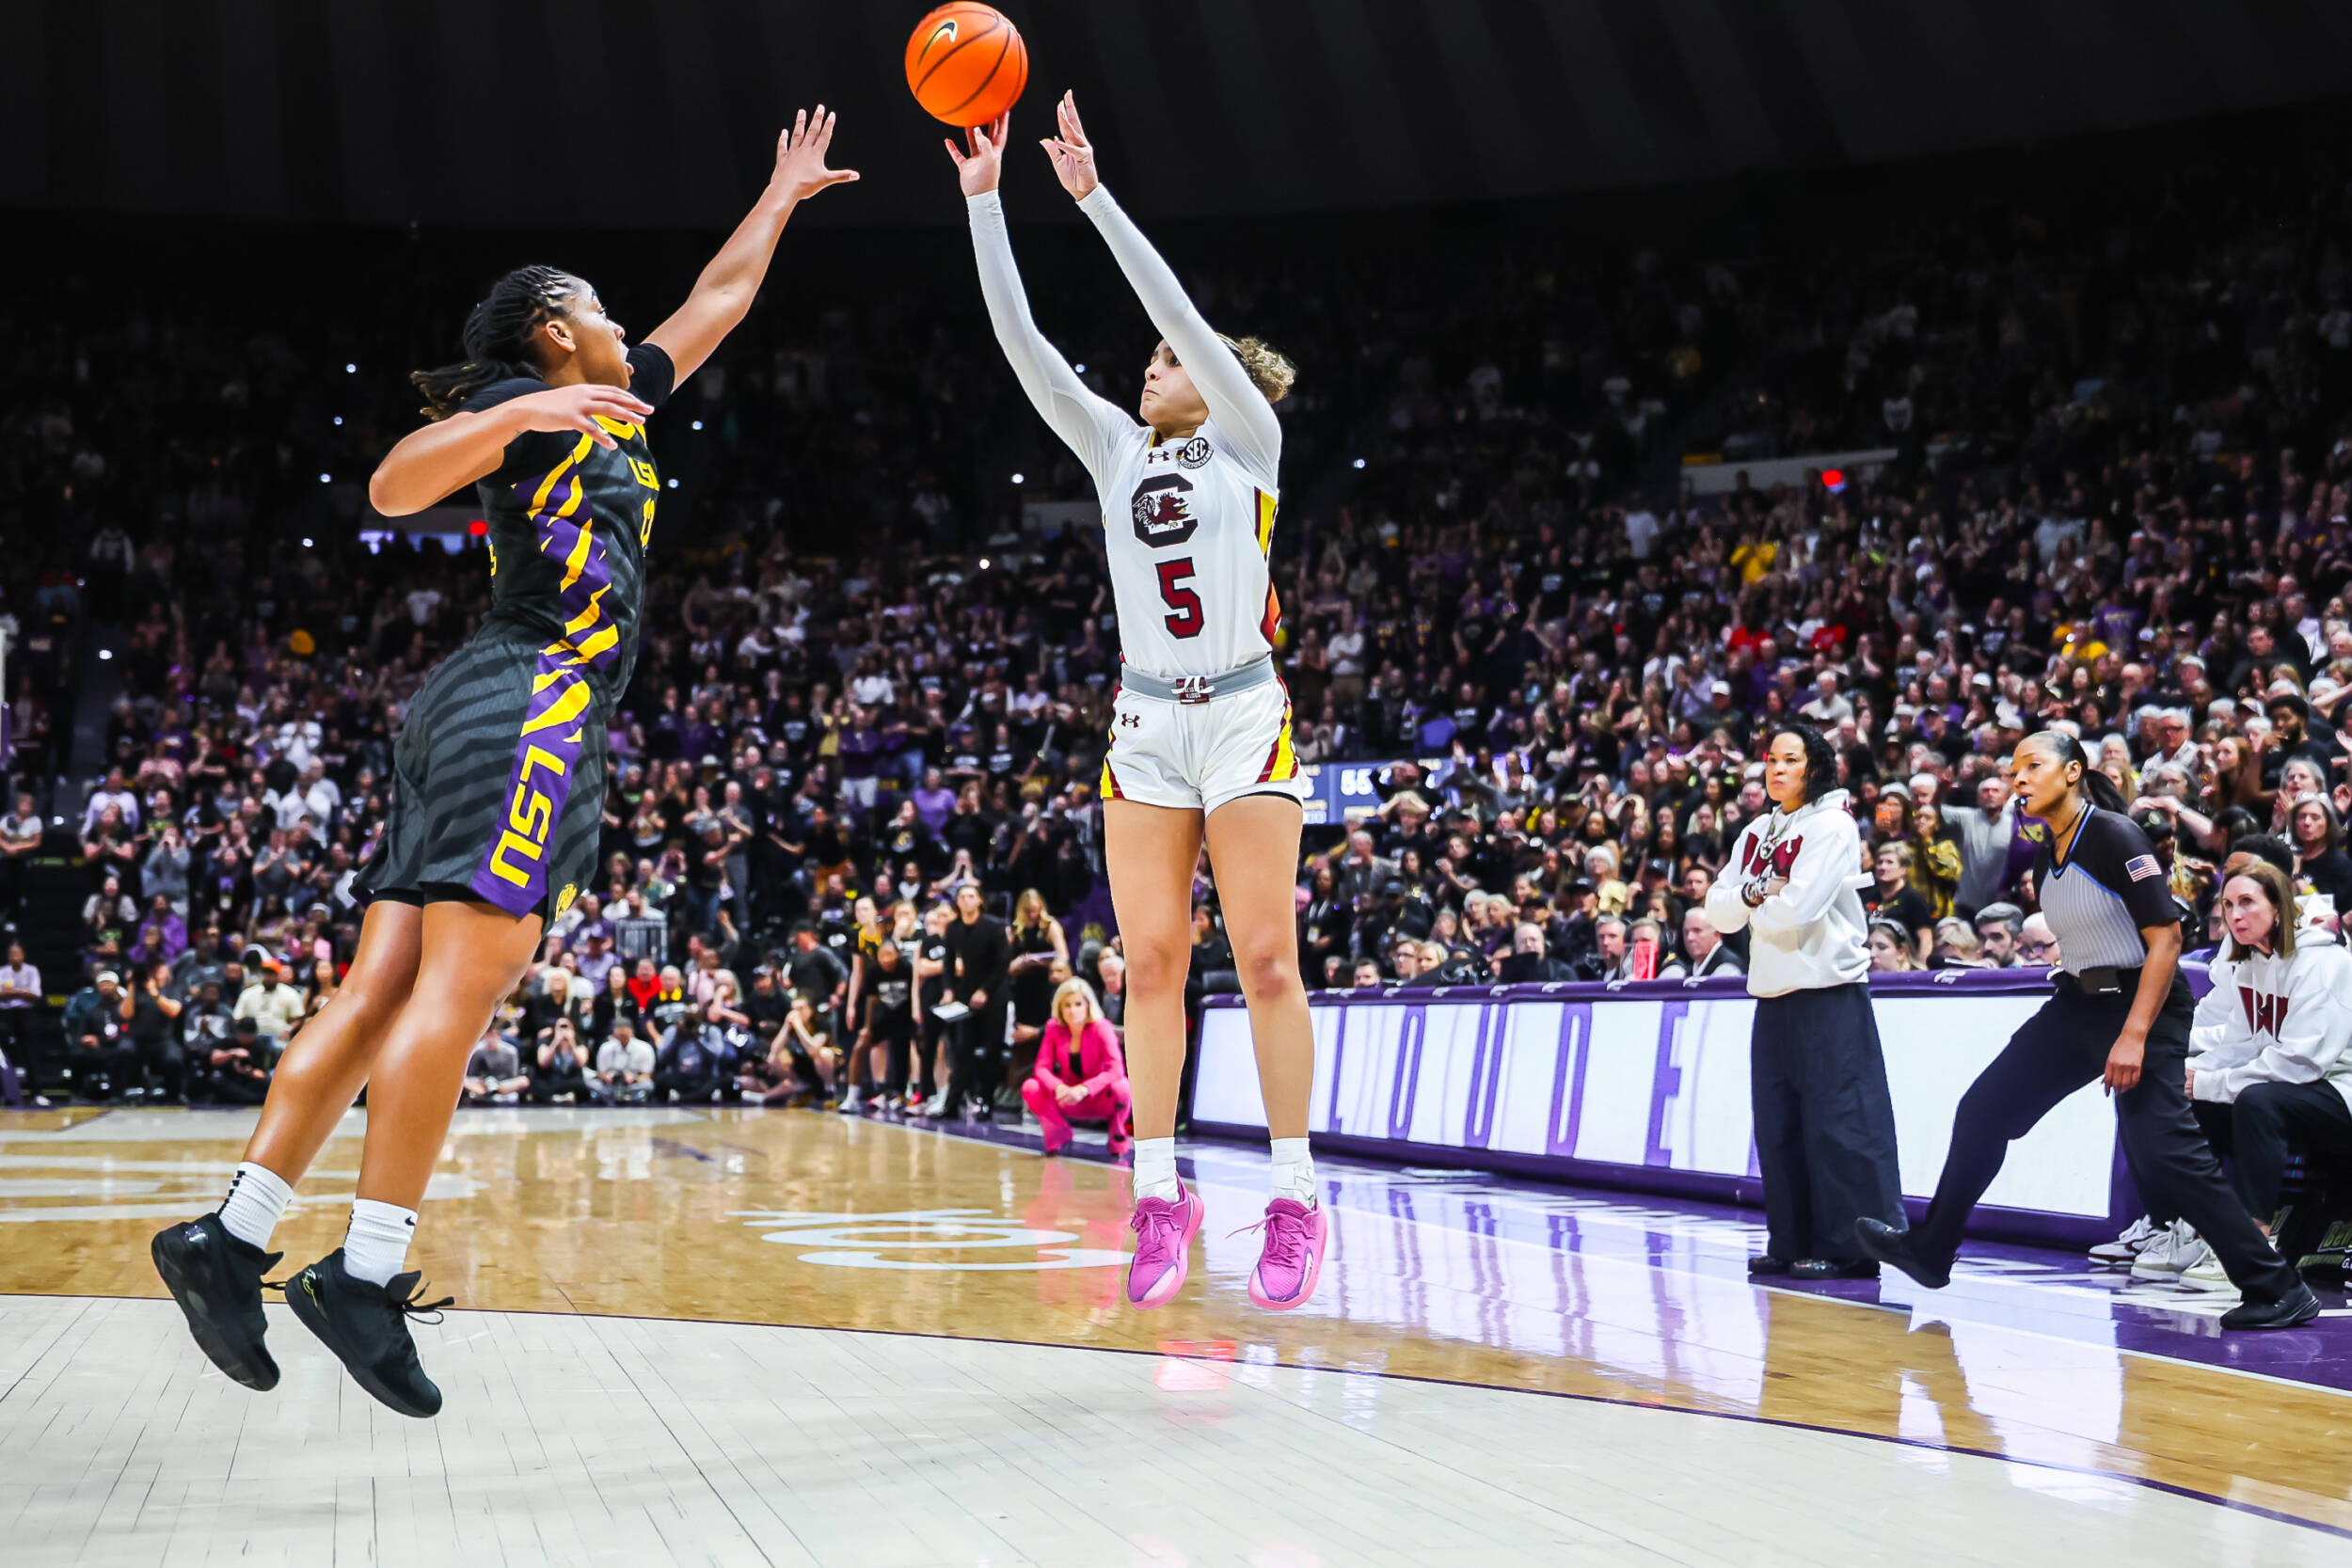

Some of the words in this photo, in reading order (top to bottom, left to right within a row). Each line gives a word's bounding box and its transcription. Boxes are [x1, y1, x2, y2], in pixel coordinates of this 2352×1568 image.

[1185, 438, 1209, 461] SEC
[1154, 557, 1204, 640] 5
[490, 744, 565, 889] LSU
[1329, 1001, 1762, 1178] LOUDE
